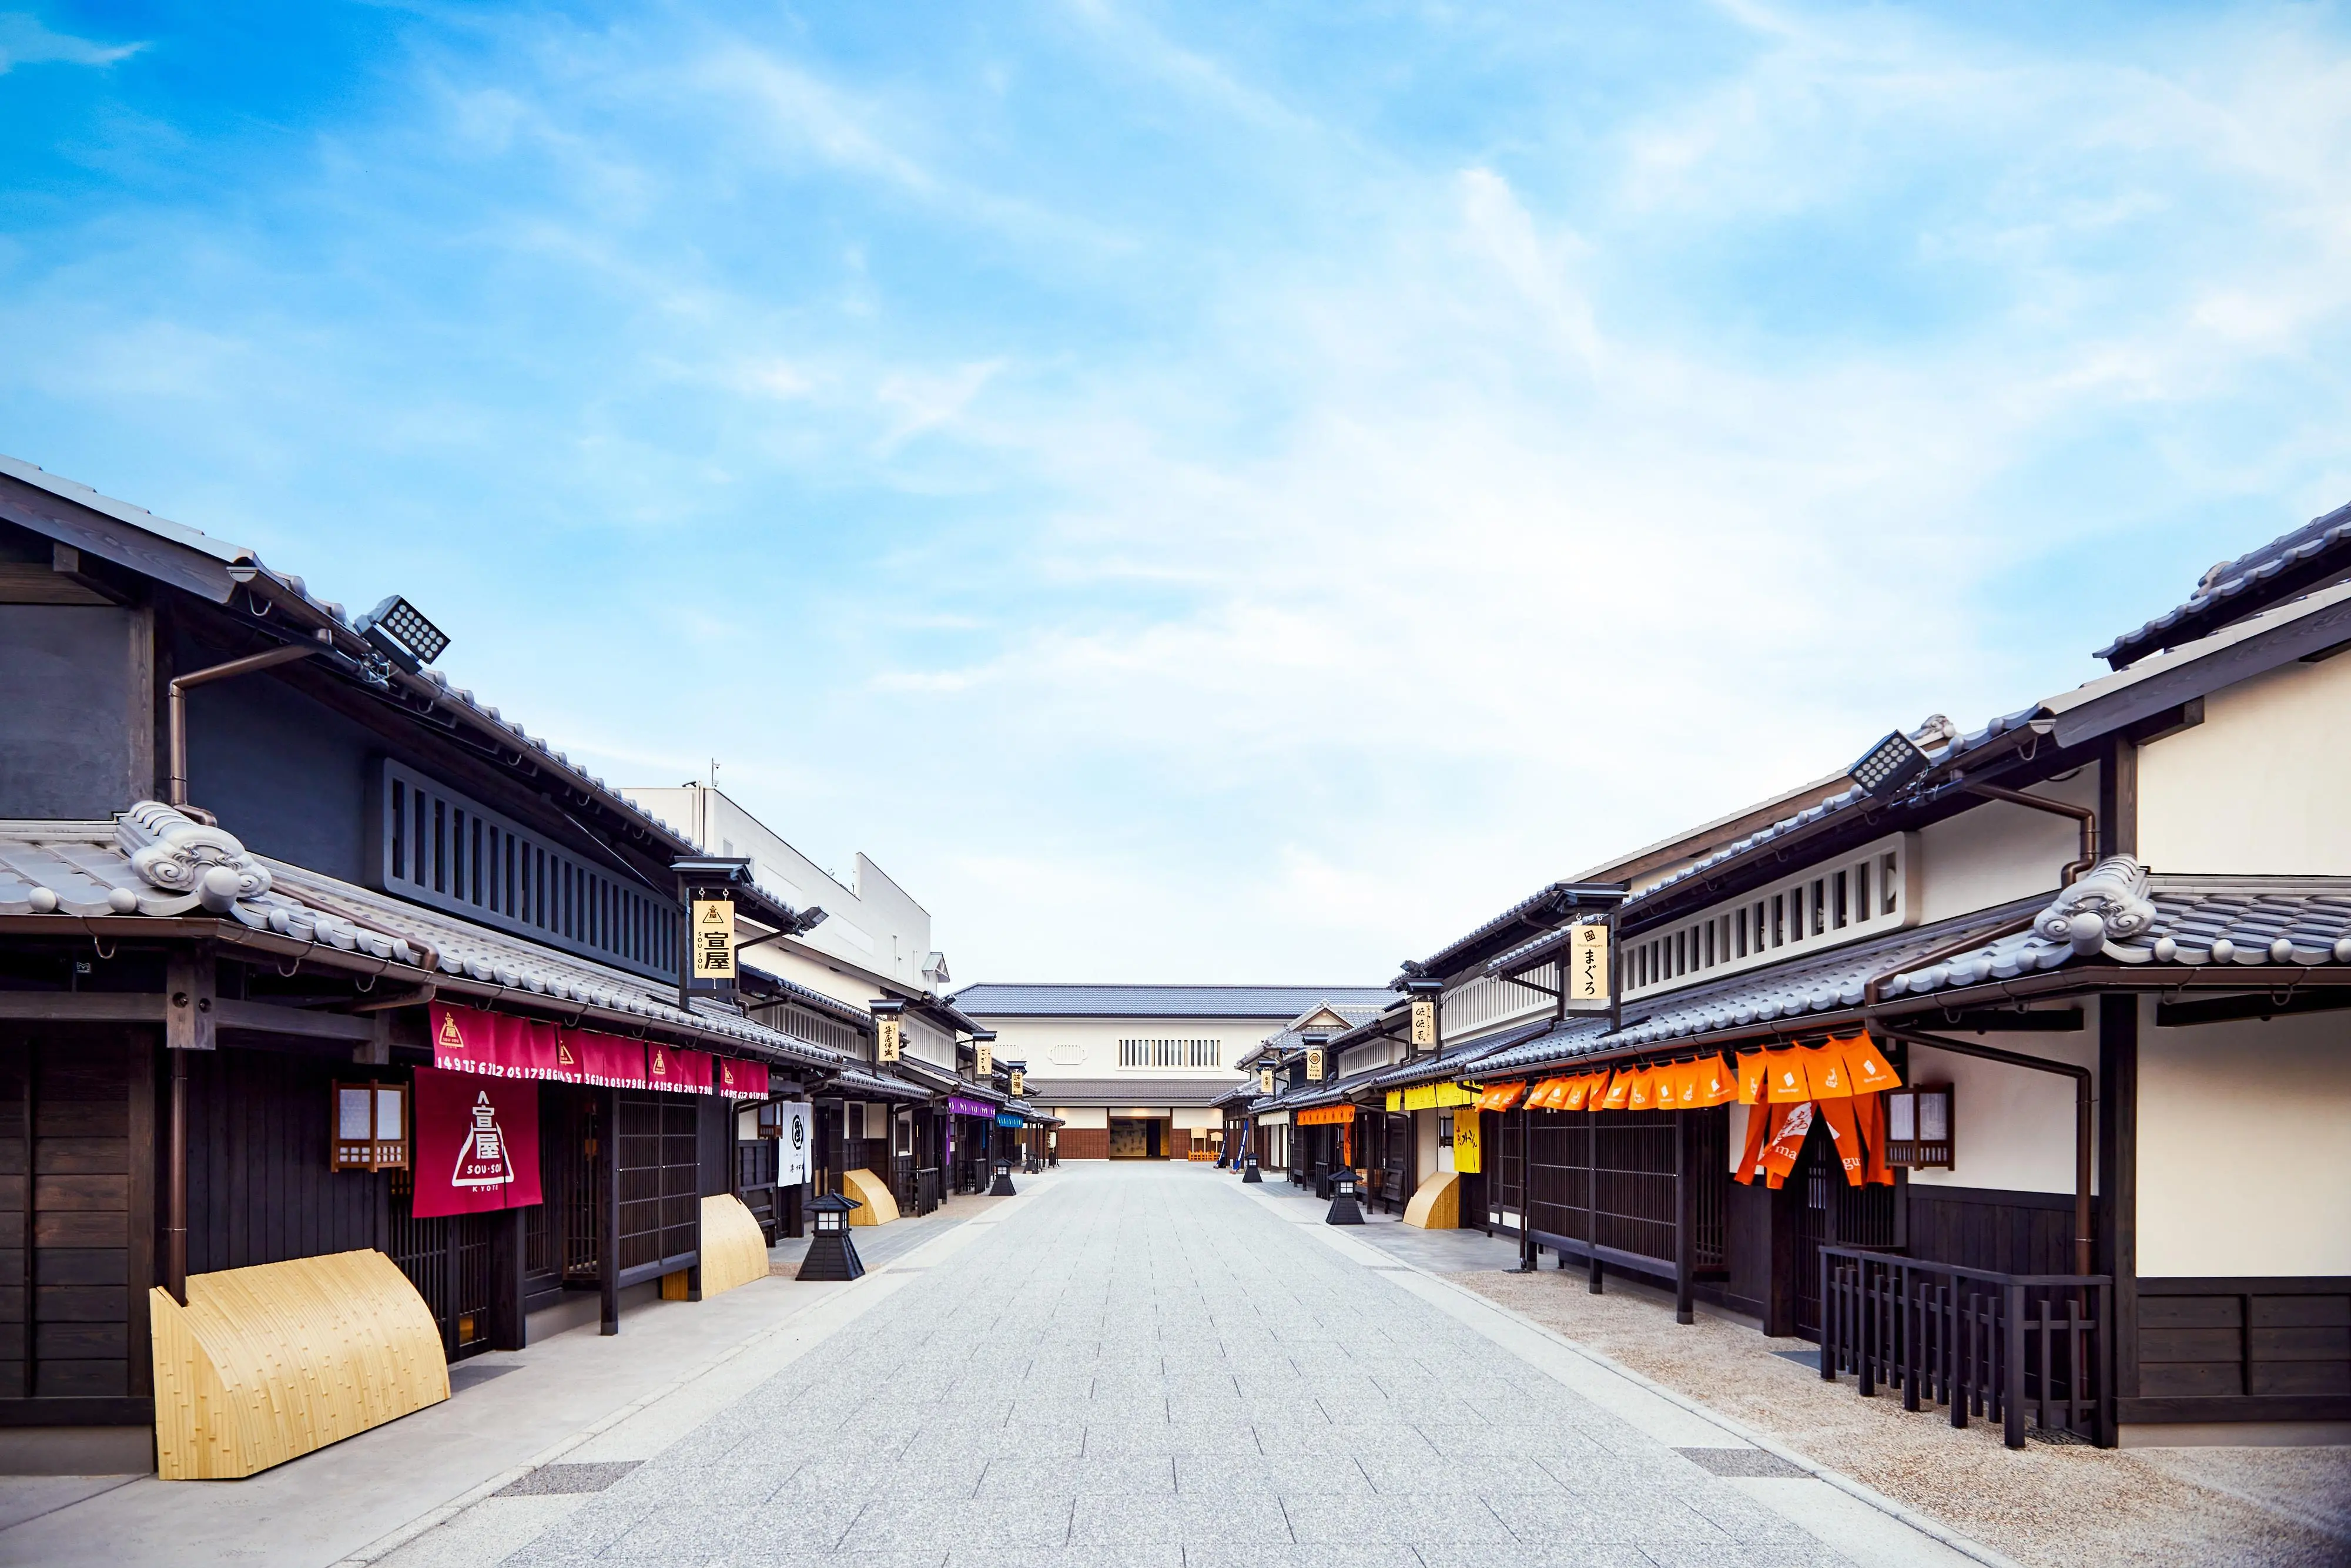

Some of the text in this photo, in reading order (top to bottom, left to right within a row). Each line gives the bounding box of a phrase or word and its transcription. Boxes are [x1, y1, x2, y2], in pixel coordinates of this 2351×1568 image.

[704, 931, 730, 969] 宣屋
[1585, 949, 1597, 995] まぐろ
[472, 1105, 500, 1159] 宣屋
[1775, 1145, 1798, 1161] ma
[472, 1184, 499, 1192] KYOTO
